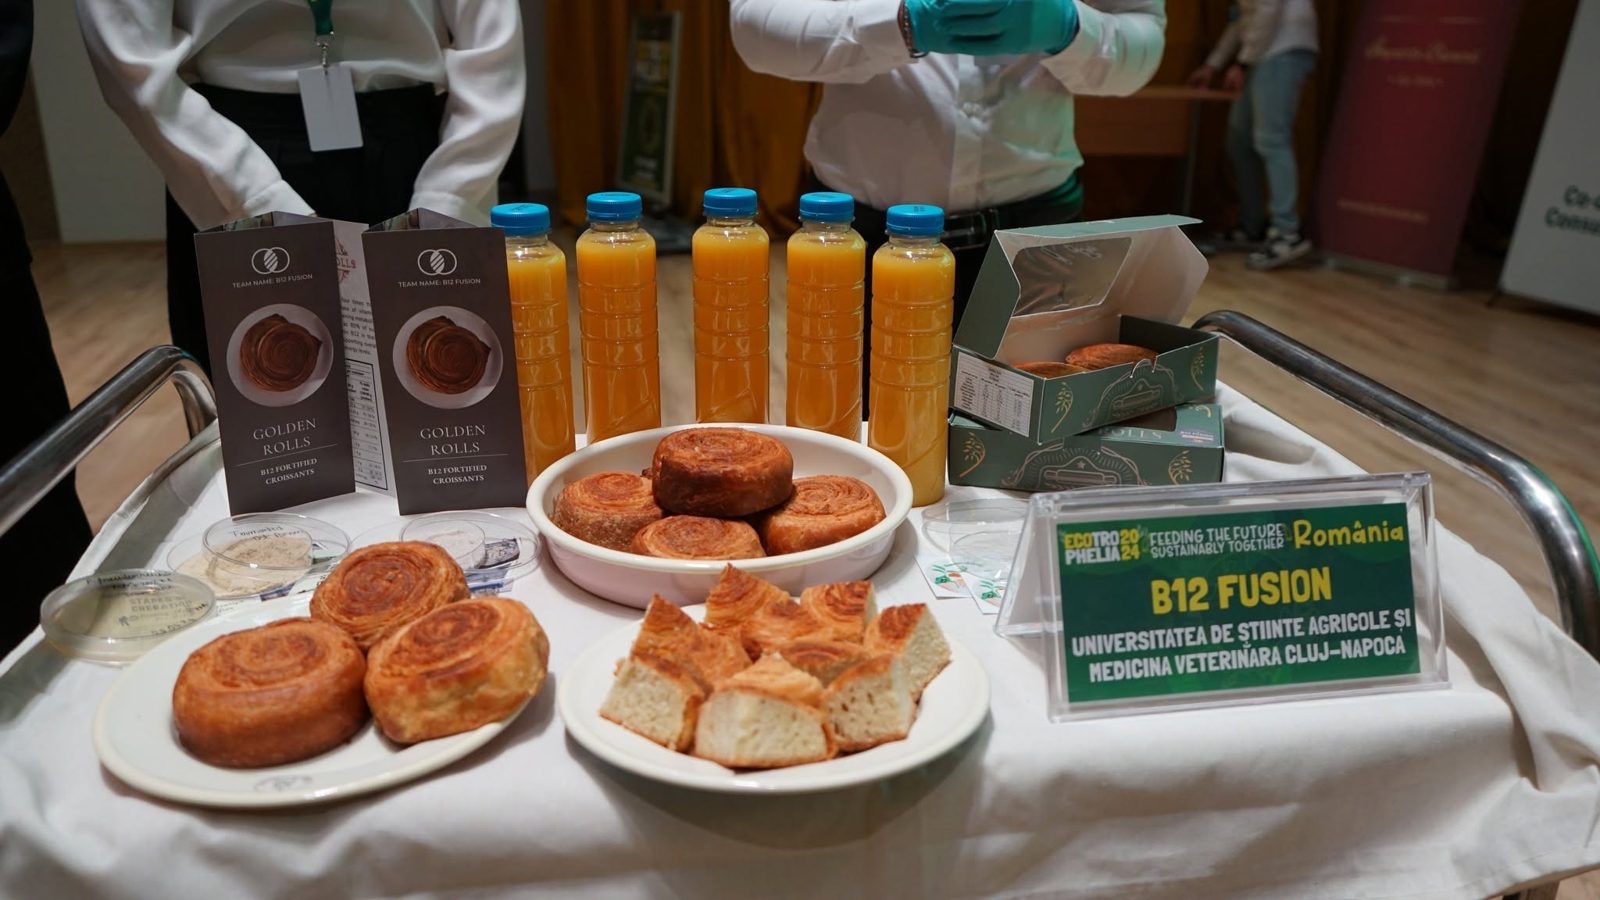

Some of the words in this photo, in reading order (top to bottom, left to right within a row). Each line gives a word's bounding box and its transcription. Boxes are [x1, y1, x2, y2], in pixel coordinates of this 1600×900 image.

[253, 278, 274, 286] NAME:
[288, 273, 313, 281] FUSION
[253, 418, 316, 440] GOLDEN
[420, 425, 486, 439] GOLDEN
[263, 436, 311, 455] ROLLS
[431, 442, 480, 455] ROLLS
[260, 468, 274, 476] B12
[275, 458, 318, 473] FORTIFIED
[265, 468, 315, 485] CROISSANTS
[443, 464, 487, 474] FORTIFIED
[433, 475, 485, 485] CROISSANTS
[1150, 528, 1203, 547] FEEDING
[1206, 527, 1230, 542] THE
[1233, 523, 1284, 540] FUTURE
[1293, 519, 1404, 549] România
[1150, 541, 1226, 559] SUSTAINABLY
[1228, 537, 1285, 552] TOGETHER
[1151, 576, 1210, 615] B12
[1217, 566, 1332, 609] FUSION
[1072, 625, 1208, 657] UNIVERSITATEA
[1210, 623, 1234, 644] DE
[1308, 610, 1391, 635] AGRICOLE
[1089, 656, 1173, 682] MEDICINA
[1285, 635, 1407, 665] CLUJ-NAPOCA
